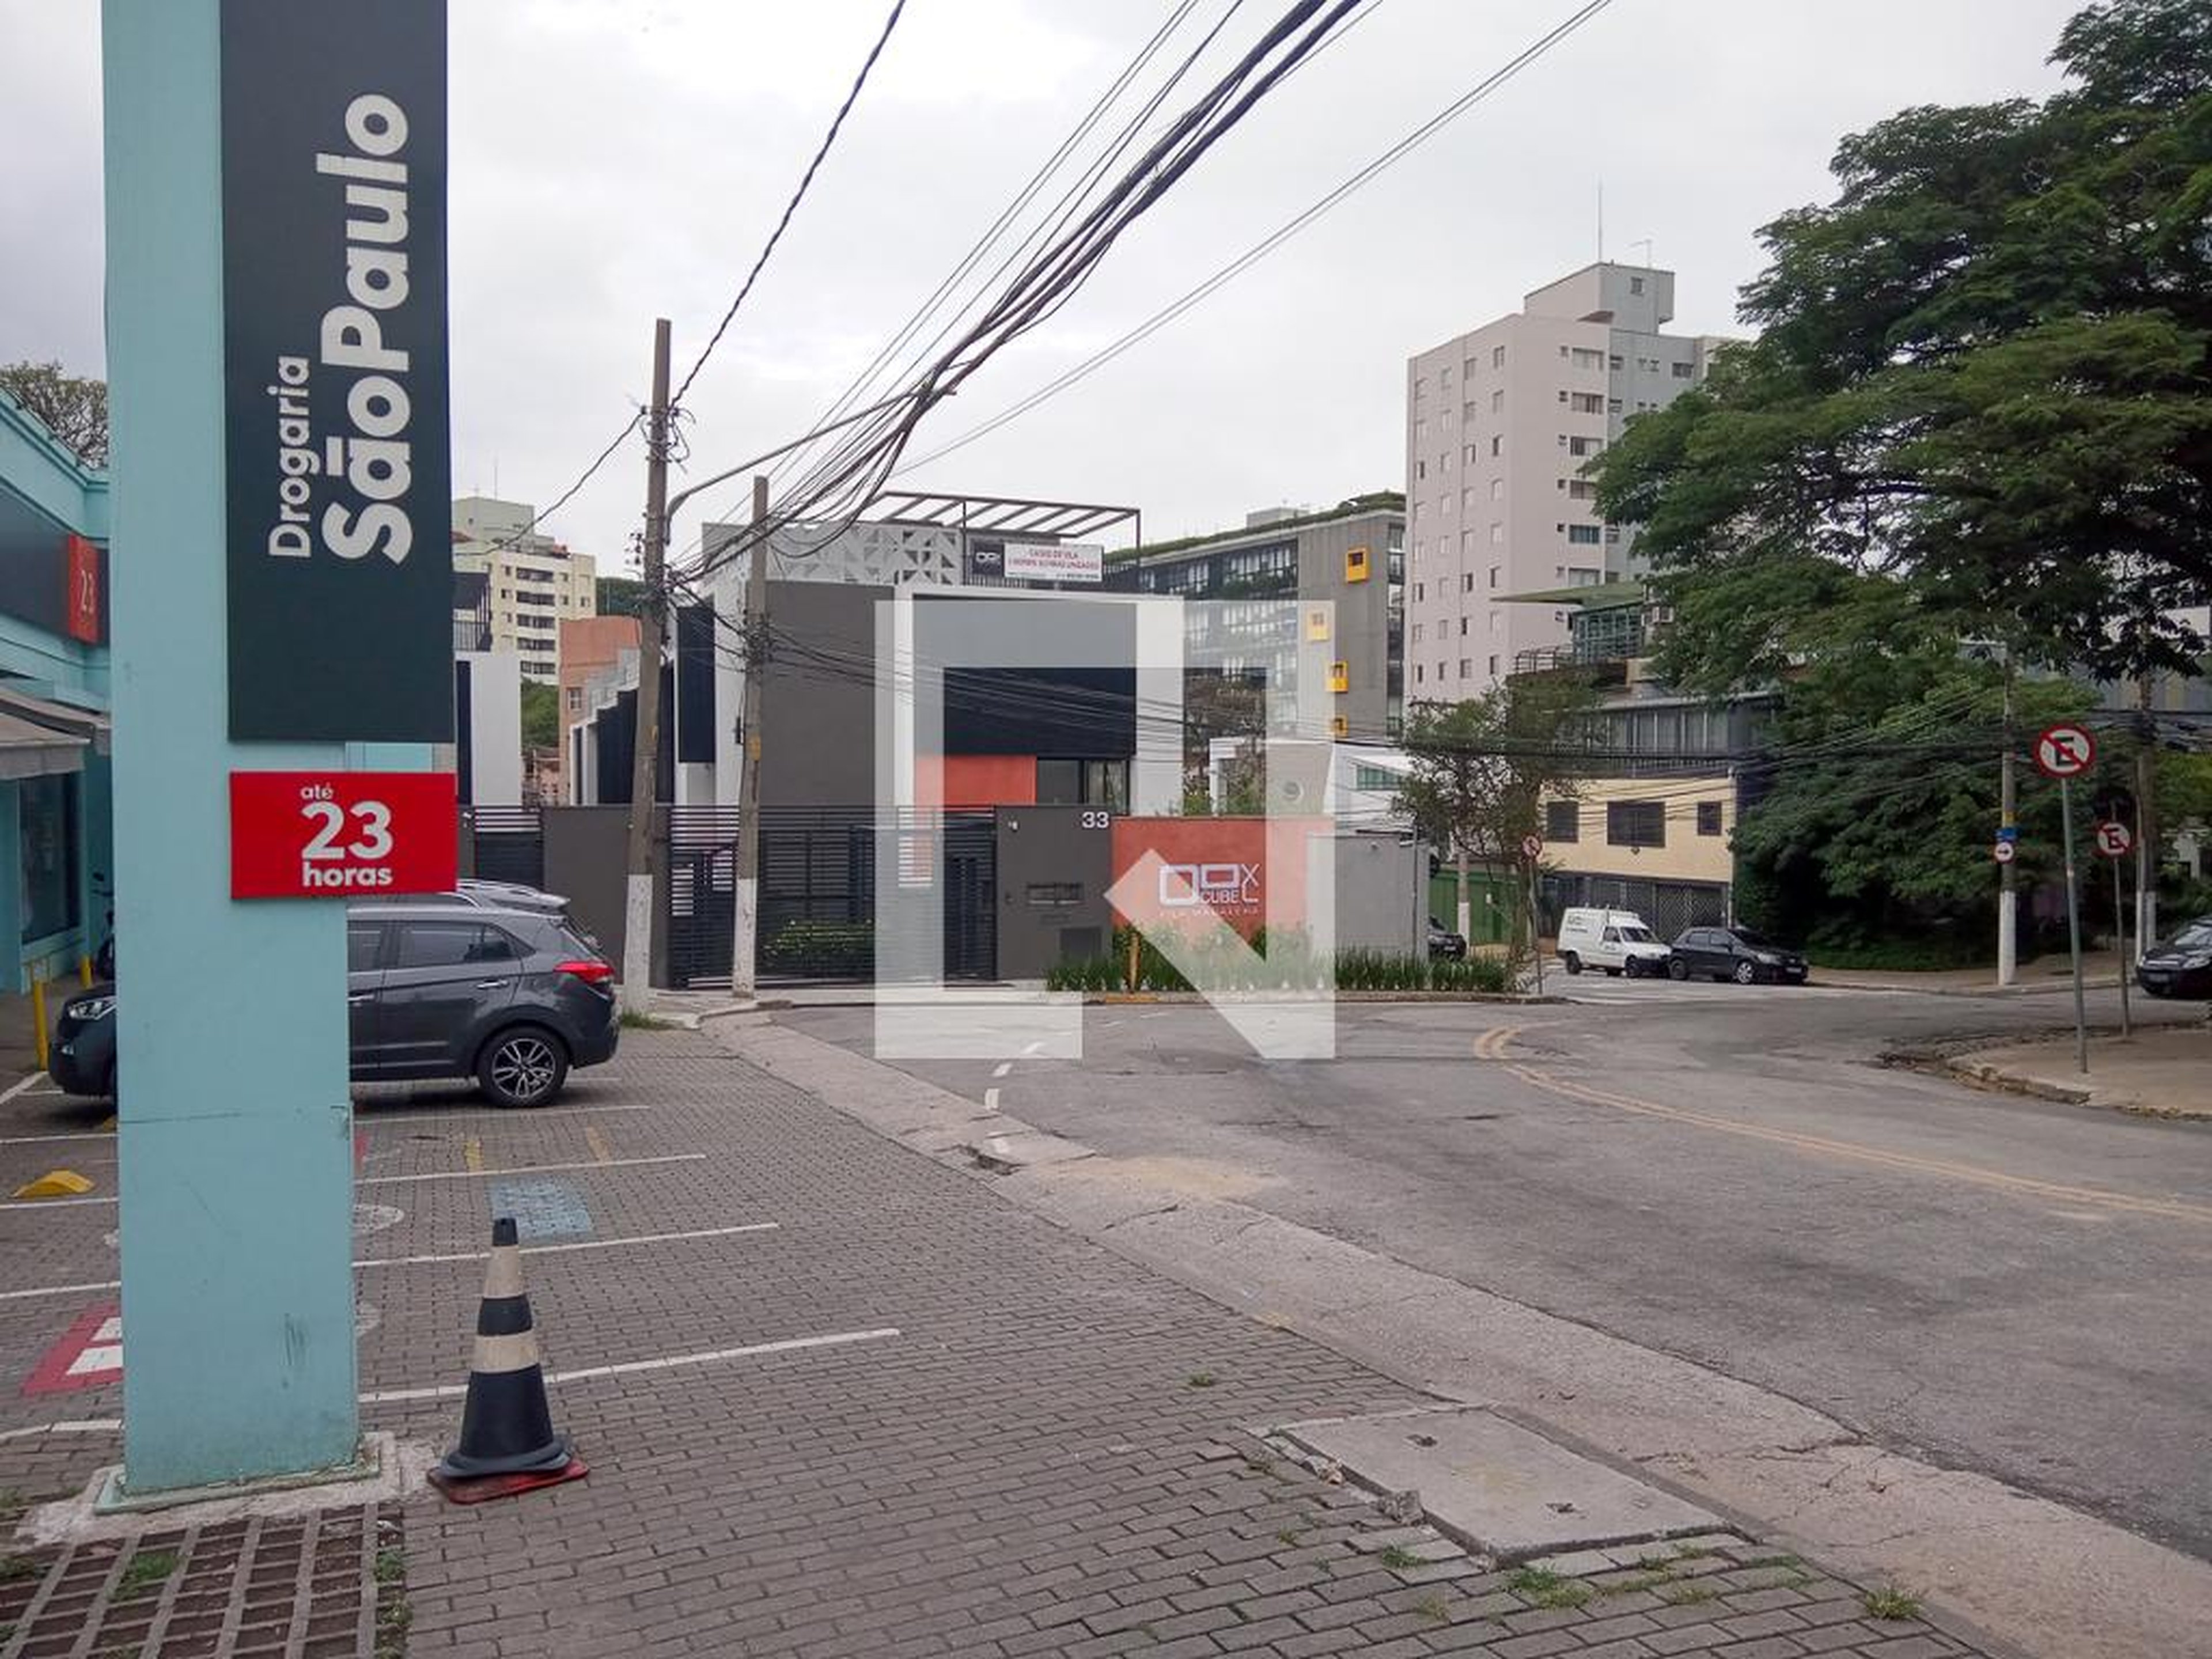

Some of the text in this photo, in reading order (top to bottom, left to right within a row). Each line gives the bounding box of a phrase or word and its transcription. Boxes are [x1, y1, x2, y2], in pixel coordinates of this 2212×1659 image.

[267, 356, 319, 558] Drogaria
[301, 782, 334, 800] até
[301, 801, 393, 859] 23
[1082, 812, 1109, 828] 33
[302, 861, 393, 887] horas
[1200, 890, 1238, 904] CUBE
